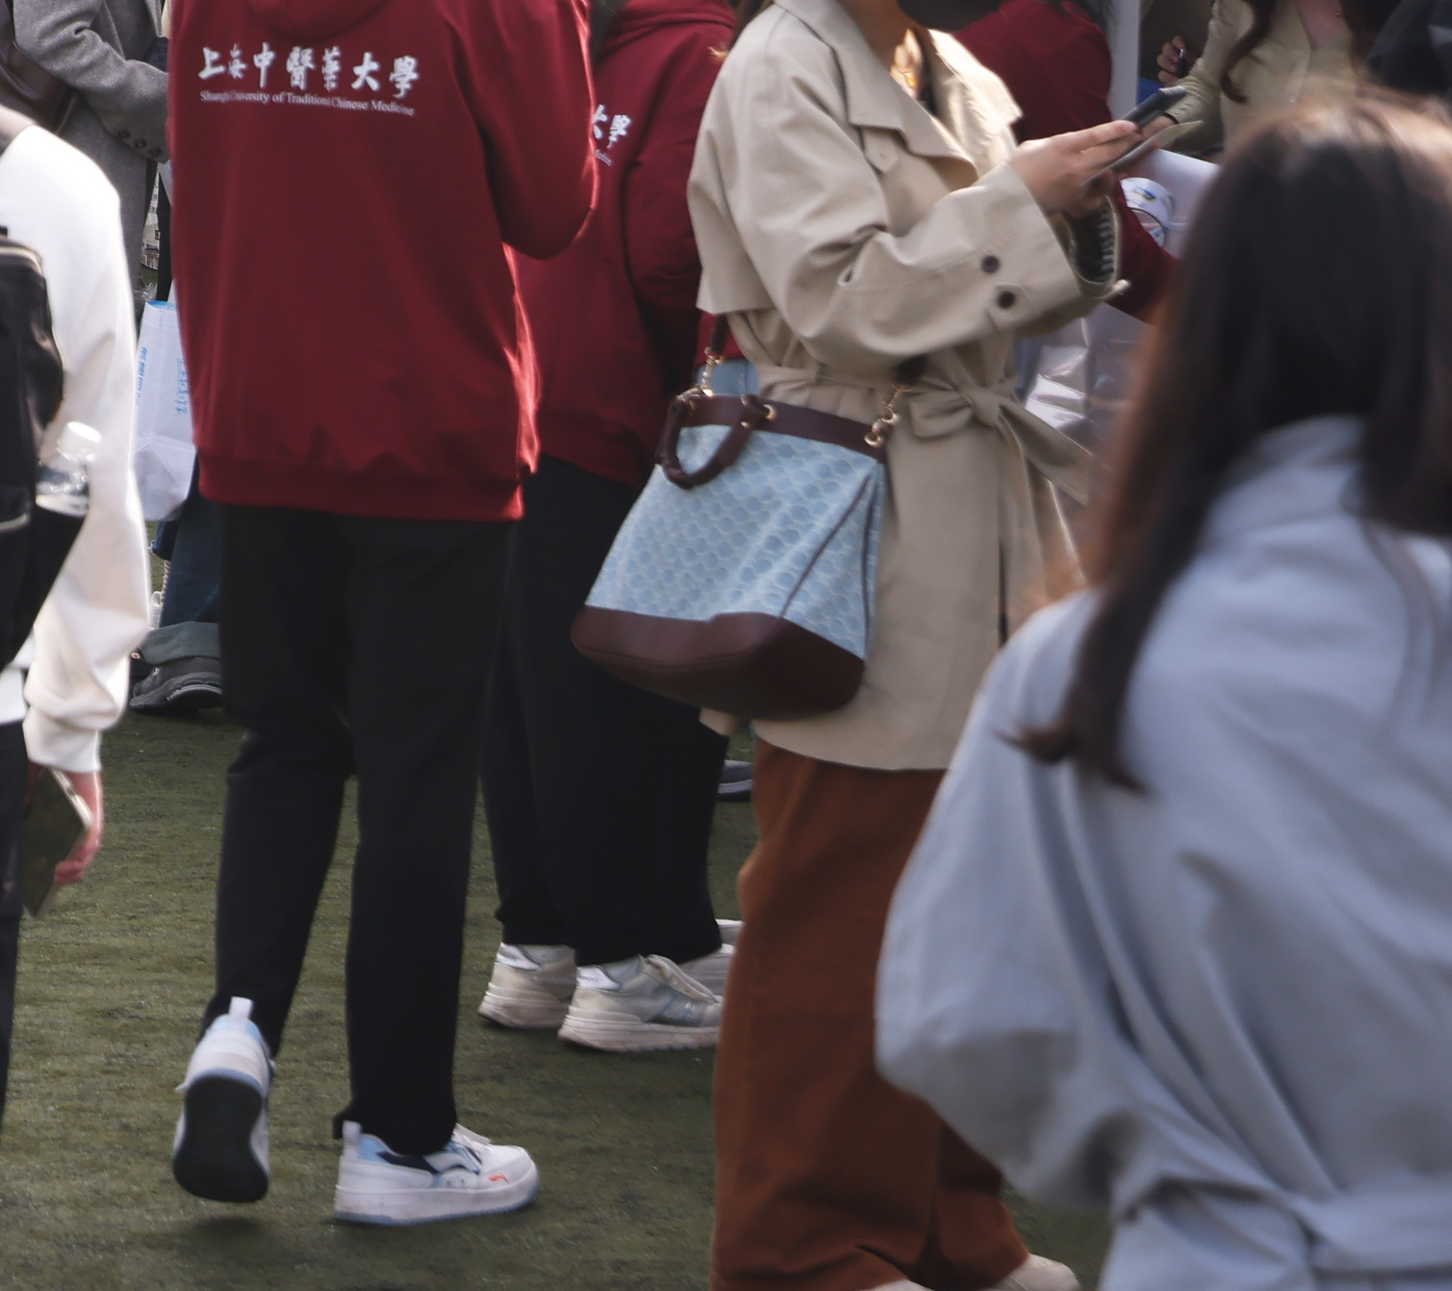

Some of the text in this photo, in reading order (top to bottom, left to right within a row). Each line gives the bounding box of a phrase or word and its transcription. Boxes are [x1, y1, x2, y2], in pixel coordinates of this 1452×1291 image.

[271, 90, 286, 102] of
[331, 96, 368, 109] Chinese
[370, 99, 415, 116] Medicine
